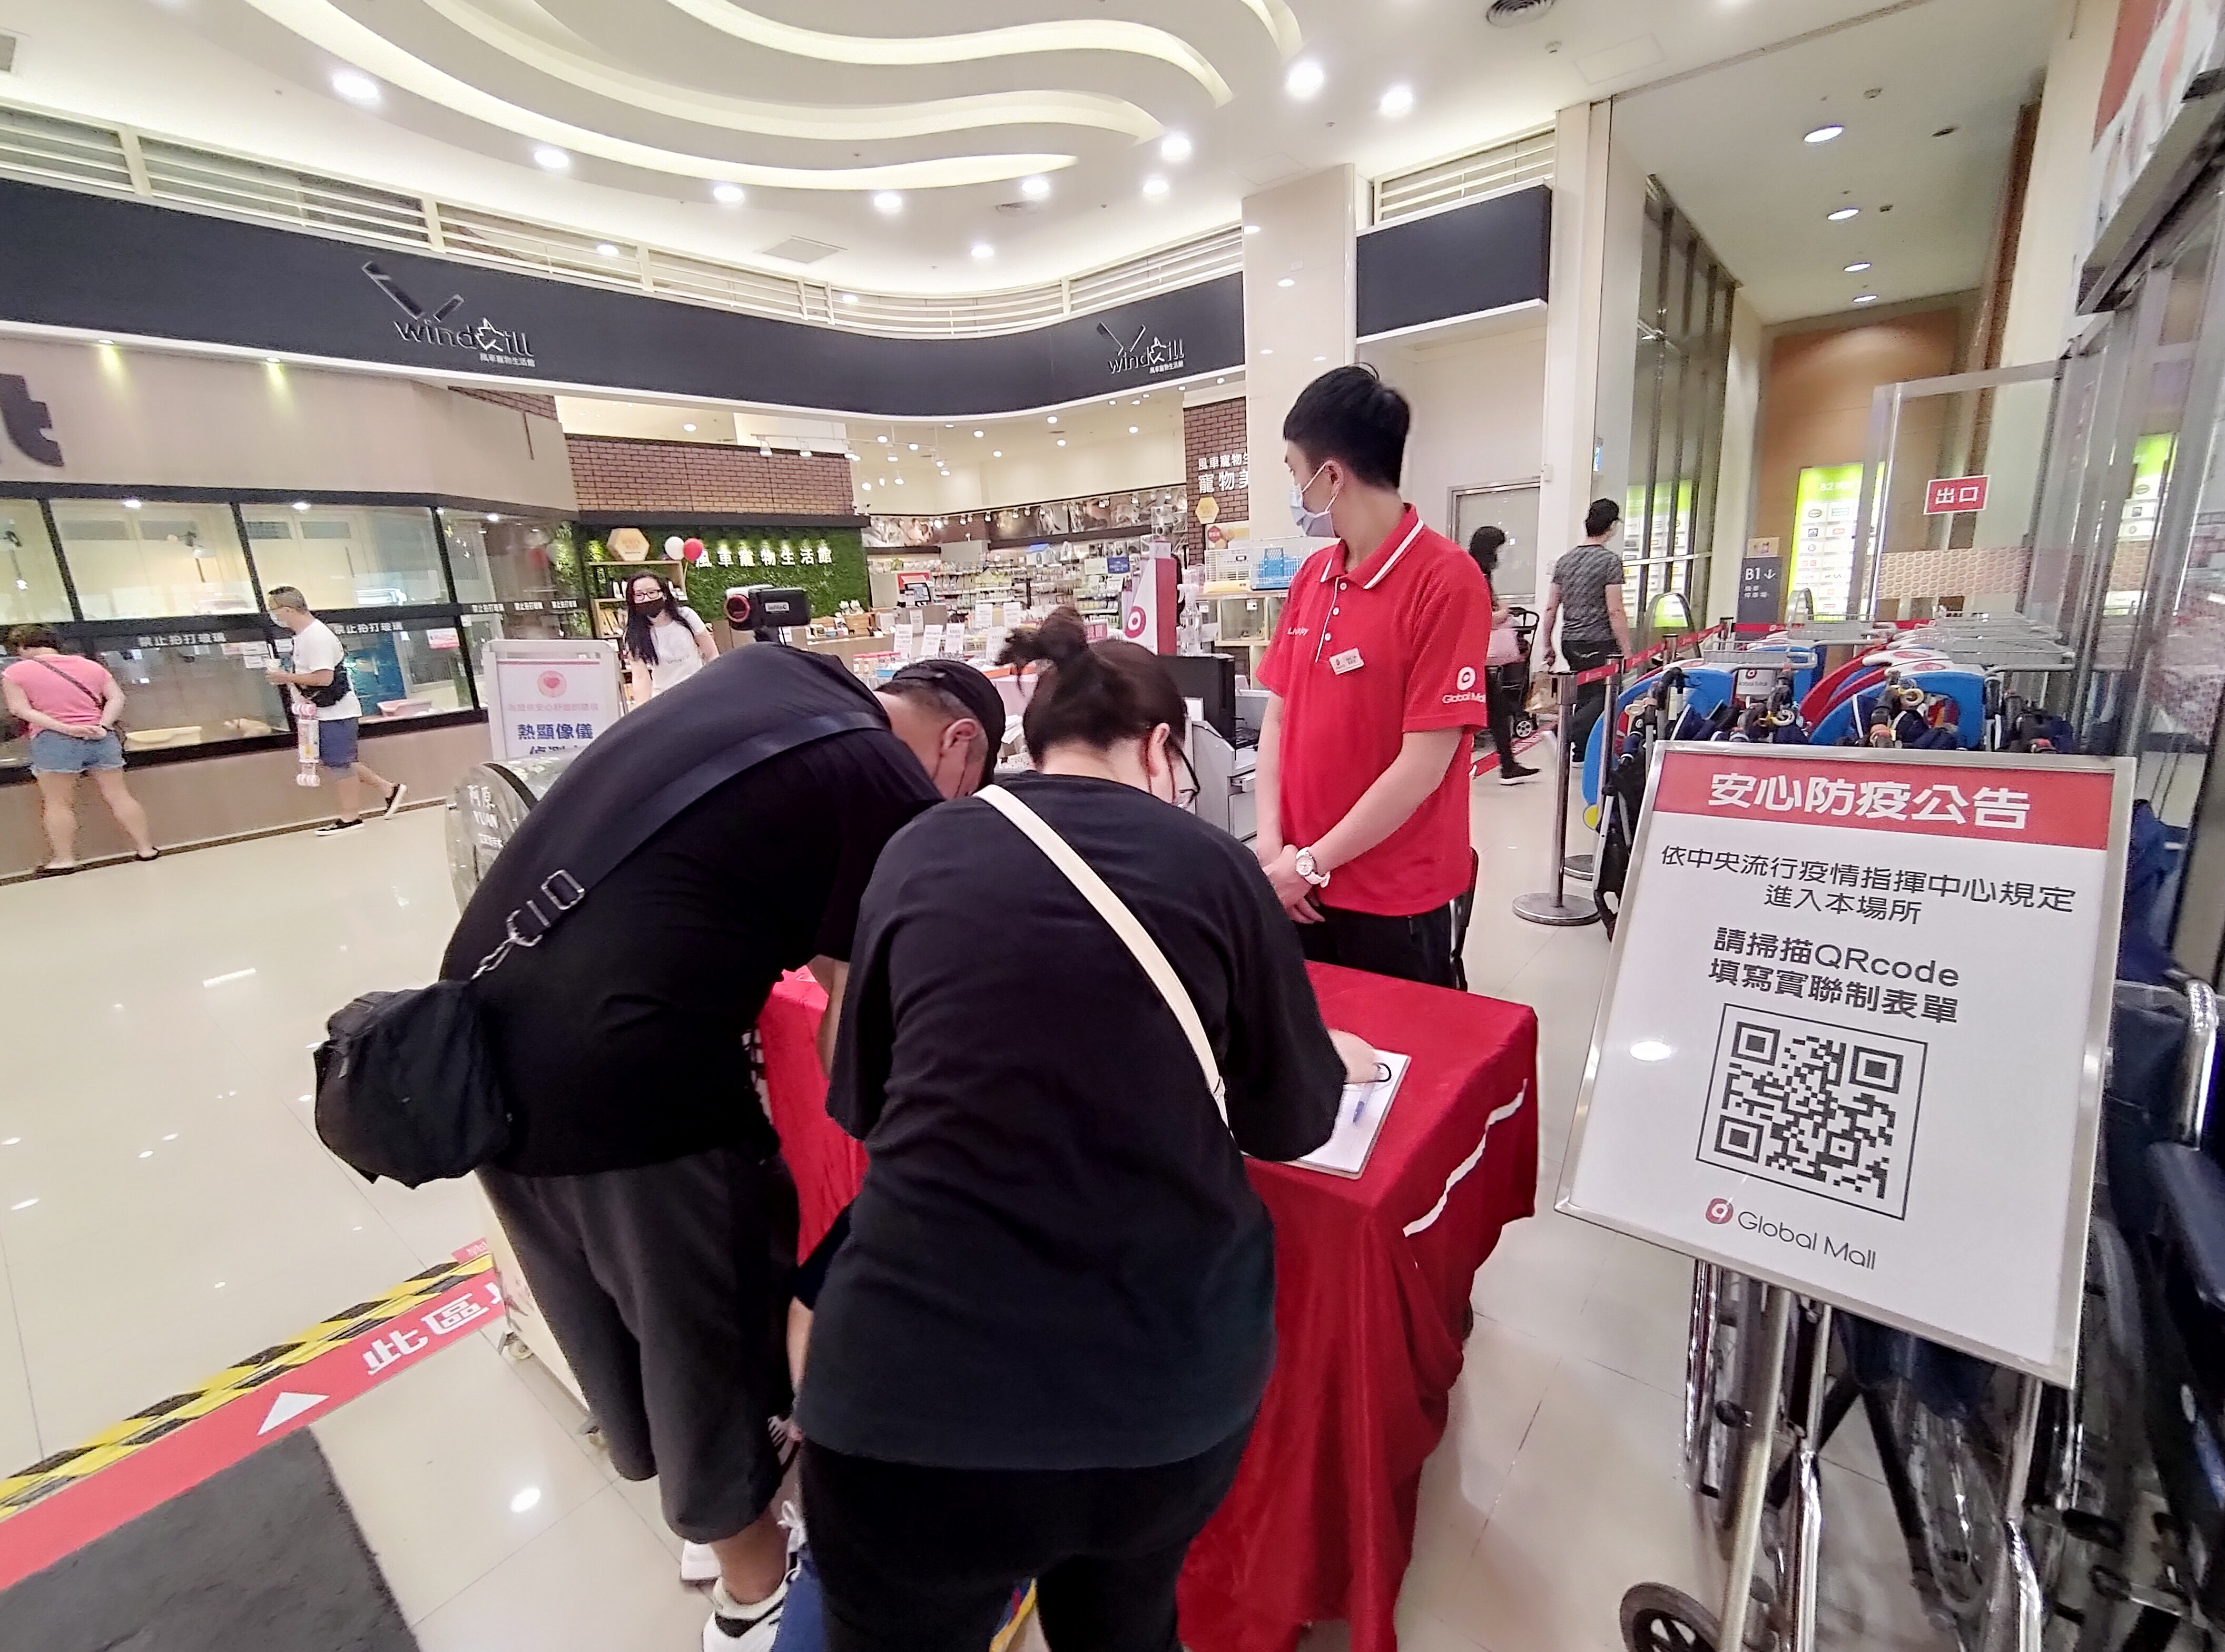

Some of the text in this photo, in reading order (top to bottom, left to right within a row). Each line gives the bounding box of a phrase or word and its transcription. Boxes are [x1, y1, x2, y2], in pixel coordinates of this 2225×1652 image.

[1935, 487, 1979, 504] 出口
[695, 548, 832, 567] 風車寵物生活館
[1745, 567, 1760, 581] B1
[517, 722, 594, 740] 熱顯像儀
[1708, 772, 2030, 830] 安心防疫公告
[1661, 844, 2076, 913] 依中央流行疫情指揮中心規定
[1763, 884, 1923, 925] 進入本場所
[1714, 927, 1960, 988] 請掃描QRcode
[1708, 958, 1958, 1024] 填寫實聯制表單
[1738, 1211, 1876, 1270] Global Mall
